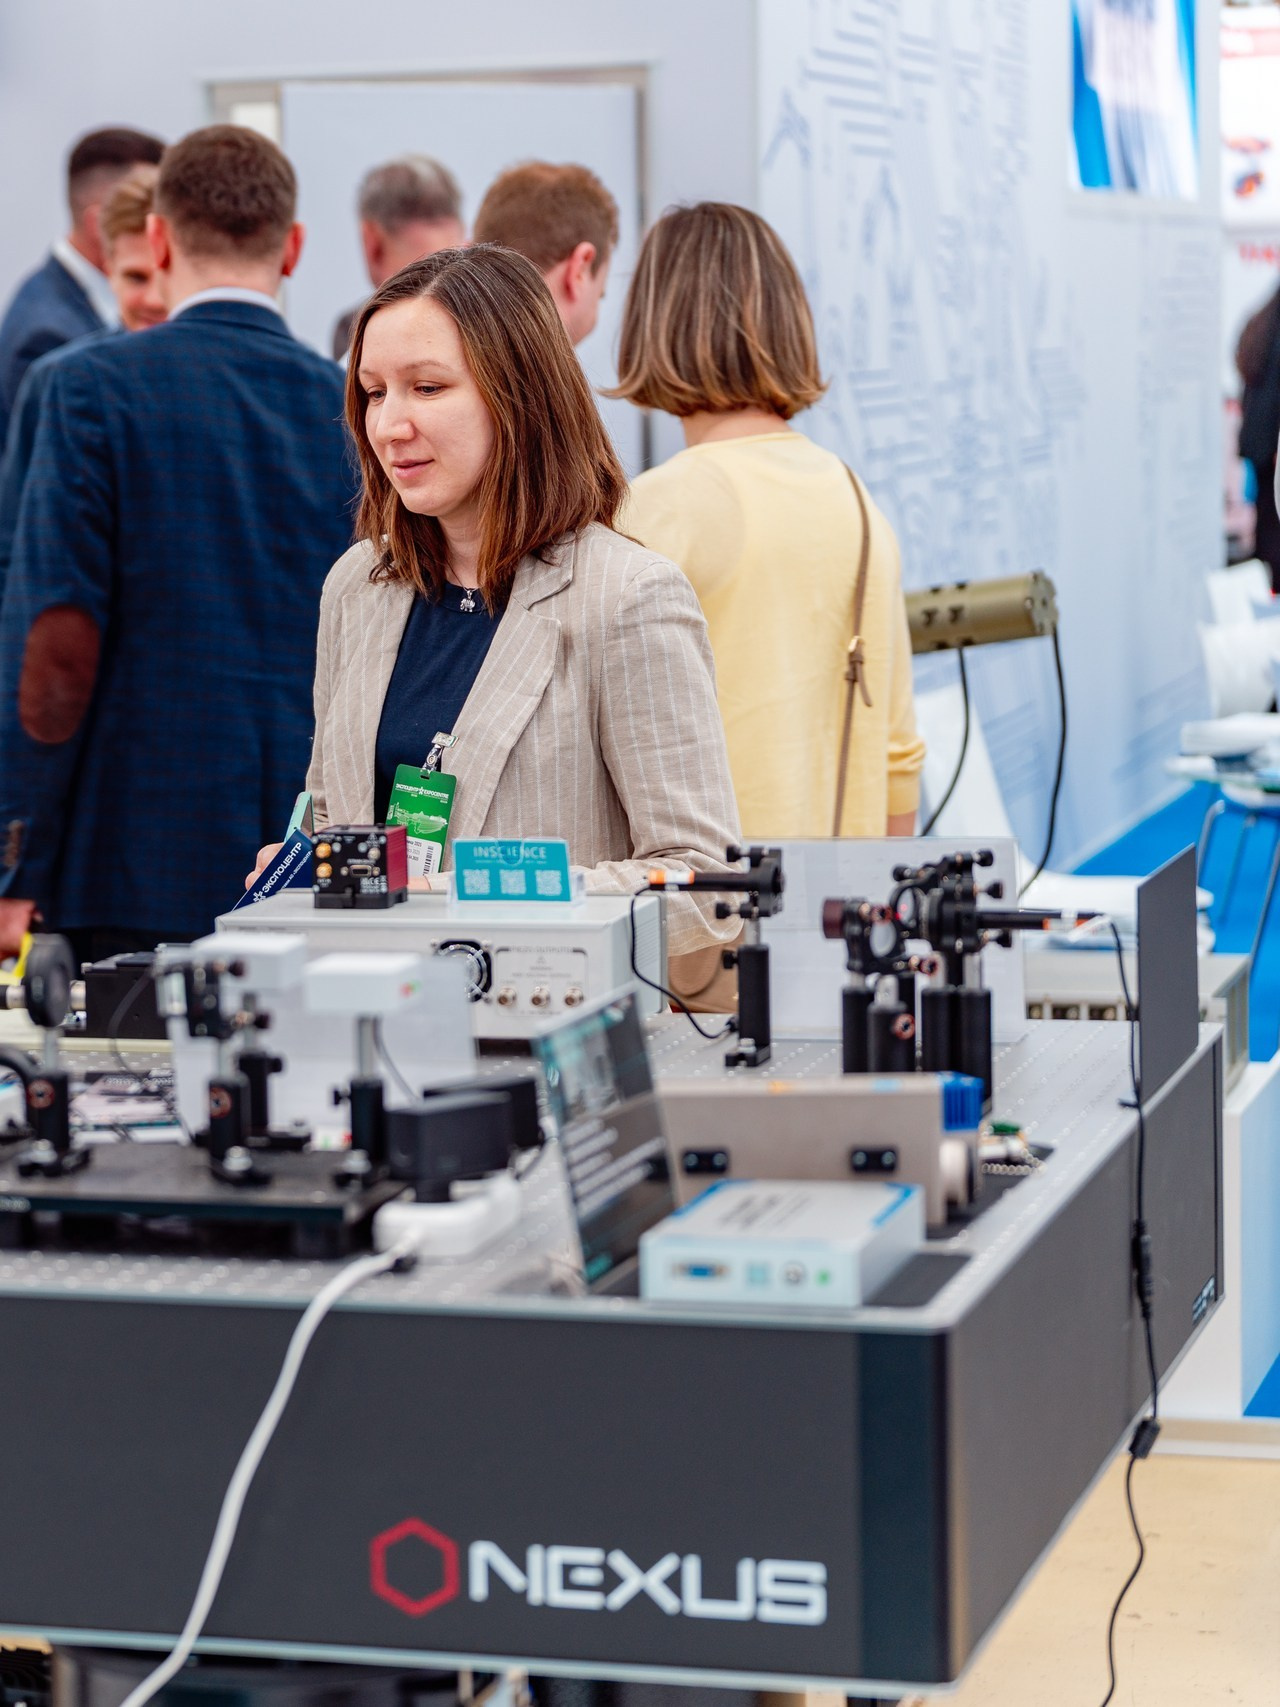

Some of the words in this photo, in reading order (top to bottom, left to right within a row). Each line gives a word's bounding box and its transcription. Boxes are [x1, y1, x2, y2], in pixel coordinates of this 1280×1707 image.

[262, 842, 302, 893] ЭКСПОЦЕНТР
[473, 846, 546, 859] INSCIENCE
[468, 1539, 828, 1626] NEXUS
